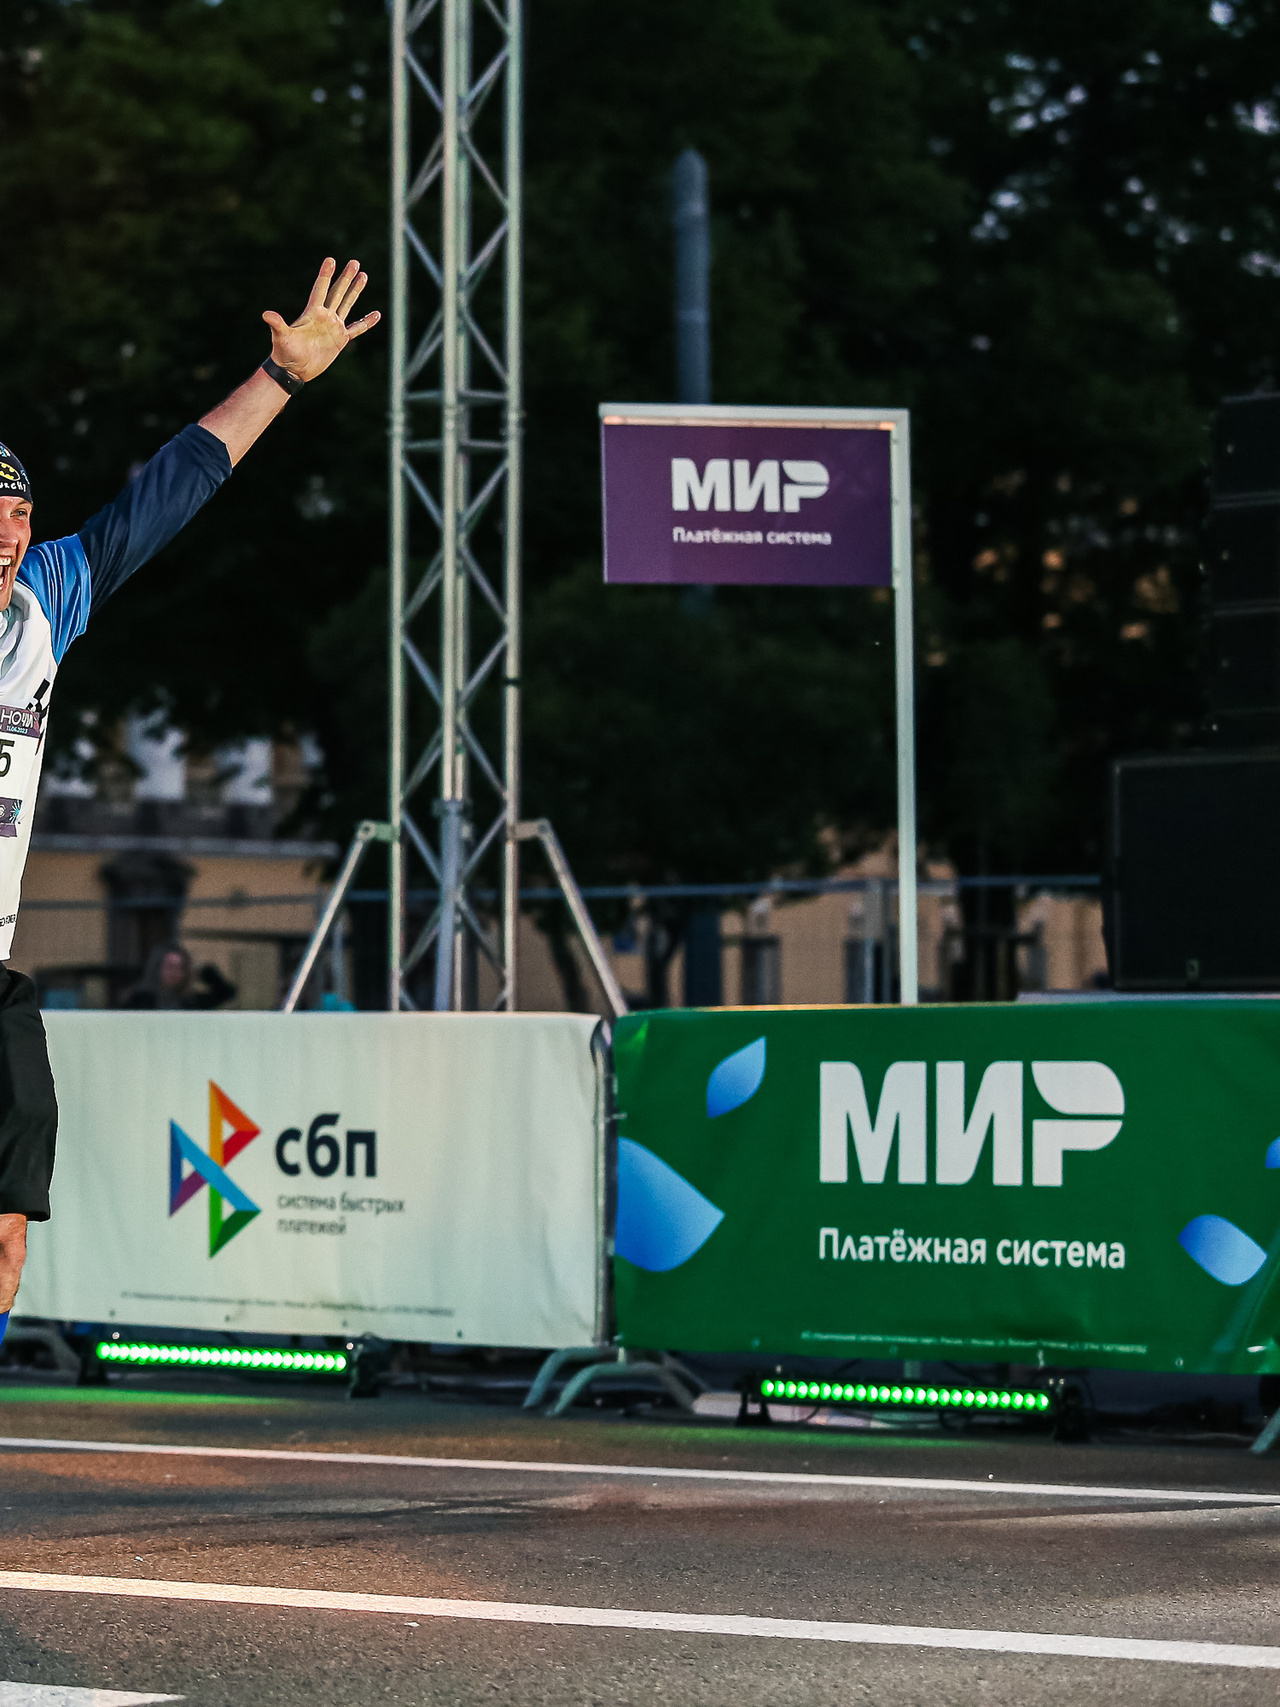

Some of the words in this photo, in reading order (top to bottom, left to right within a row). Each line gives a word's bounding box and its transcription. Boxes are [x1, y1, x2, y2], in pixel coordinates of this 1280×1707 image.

[671, 458, 830, 513] МИР
[766, 531, 832, 546] система
[0, 709, 34, 728] НОЧИ
[275, 1112, 377, 1178] сбп
[819, 1061, 1125, 1187] МИР
[277, 1194, 337, 1211] система
[340, 1192, 405, 1216] быстрых
[819, 1227, 986, 1264] Платёжная
[996, 1238, 1125, 1269] система
